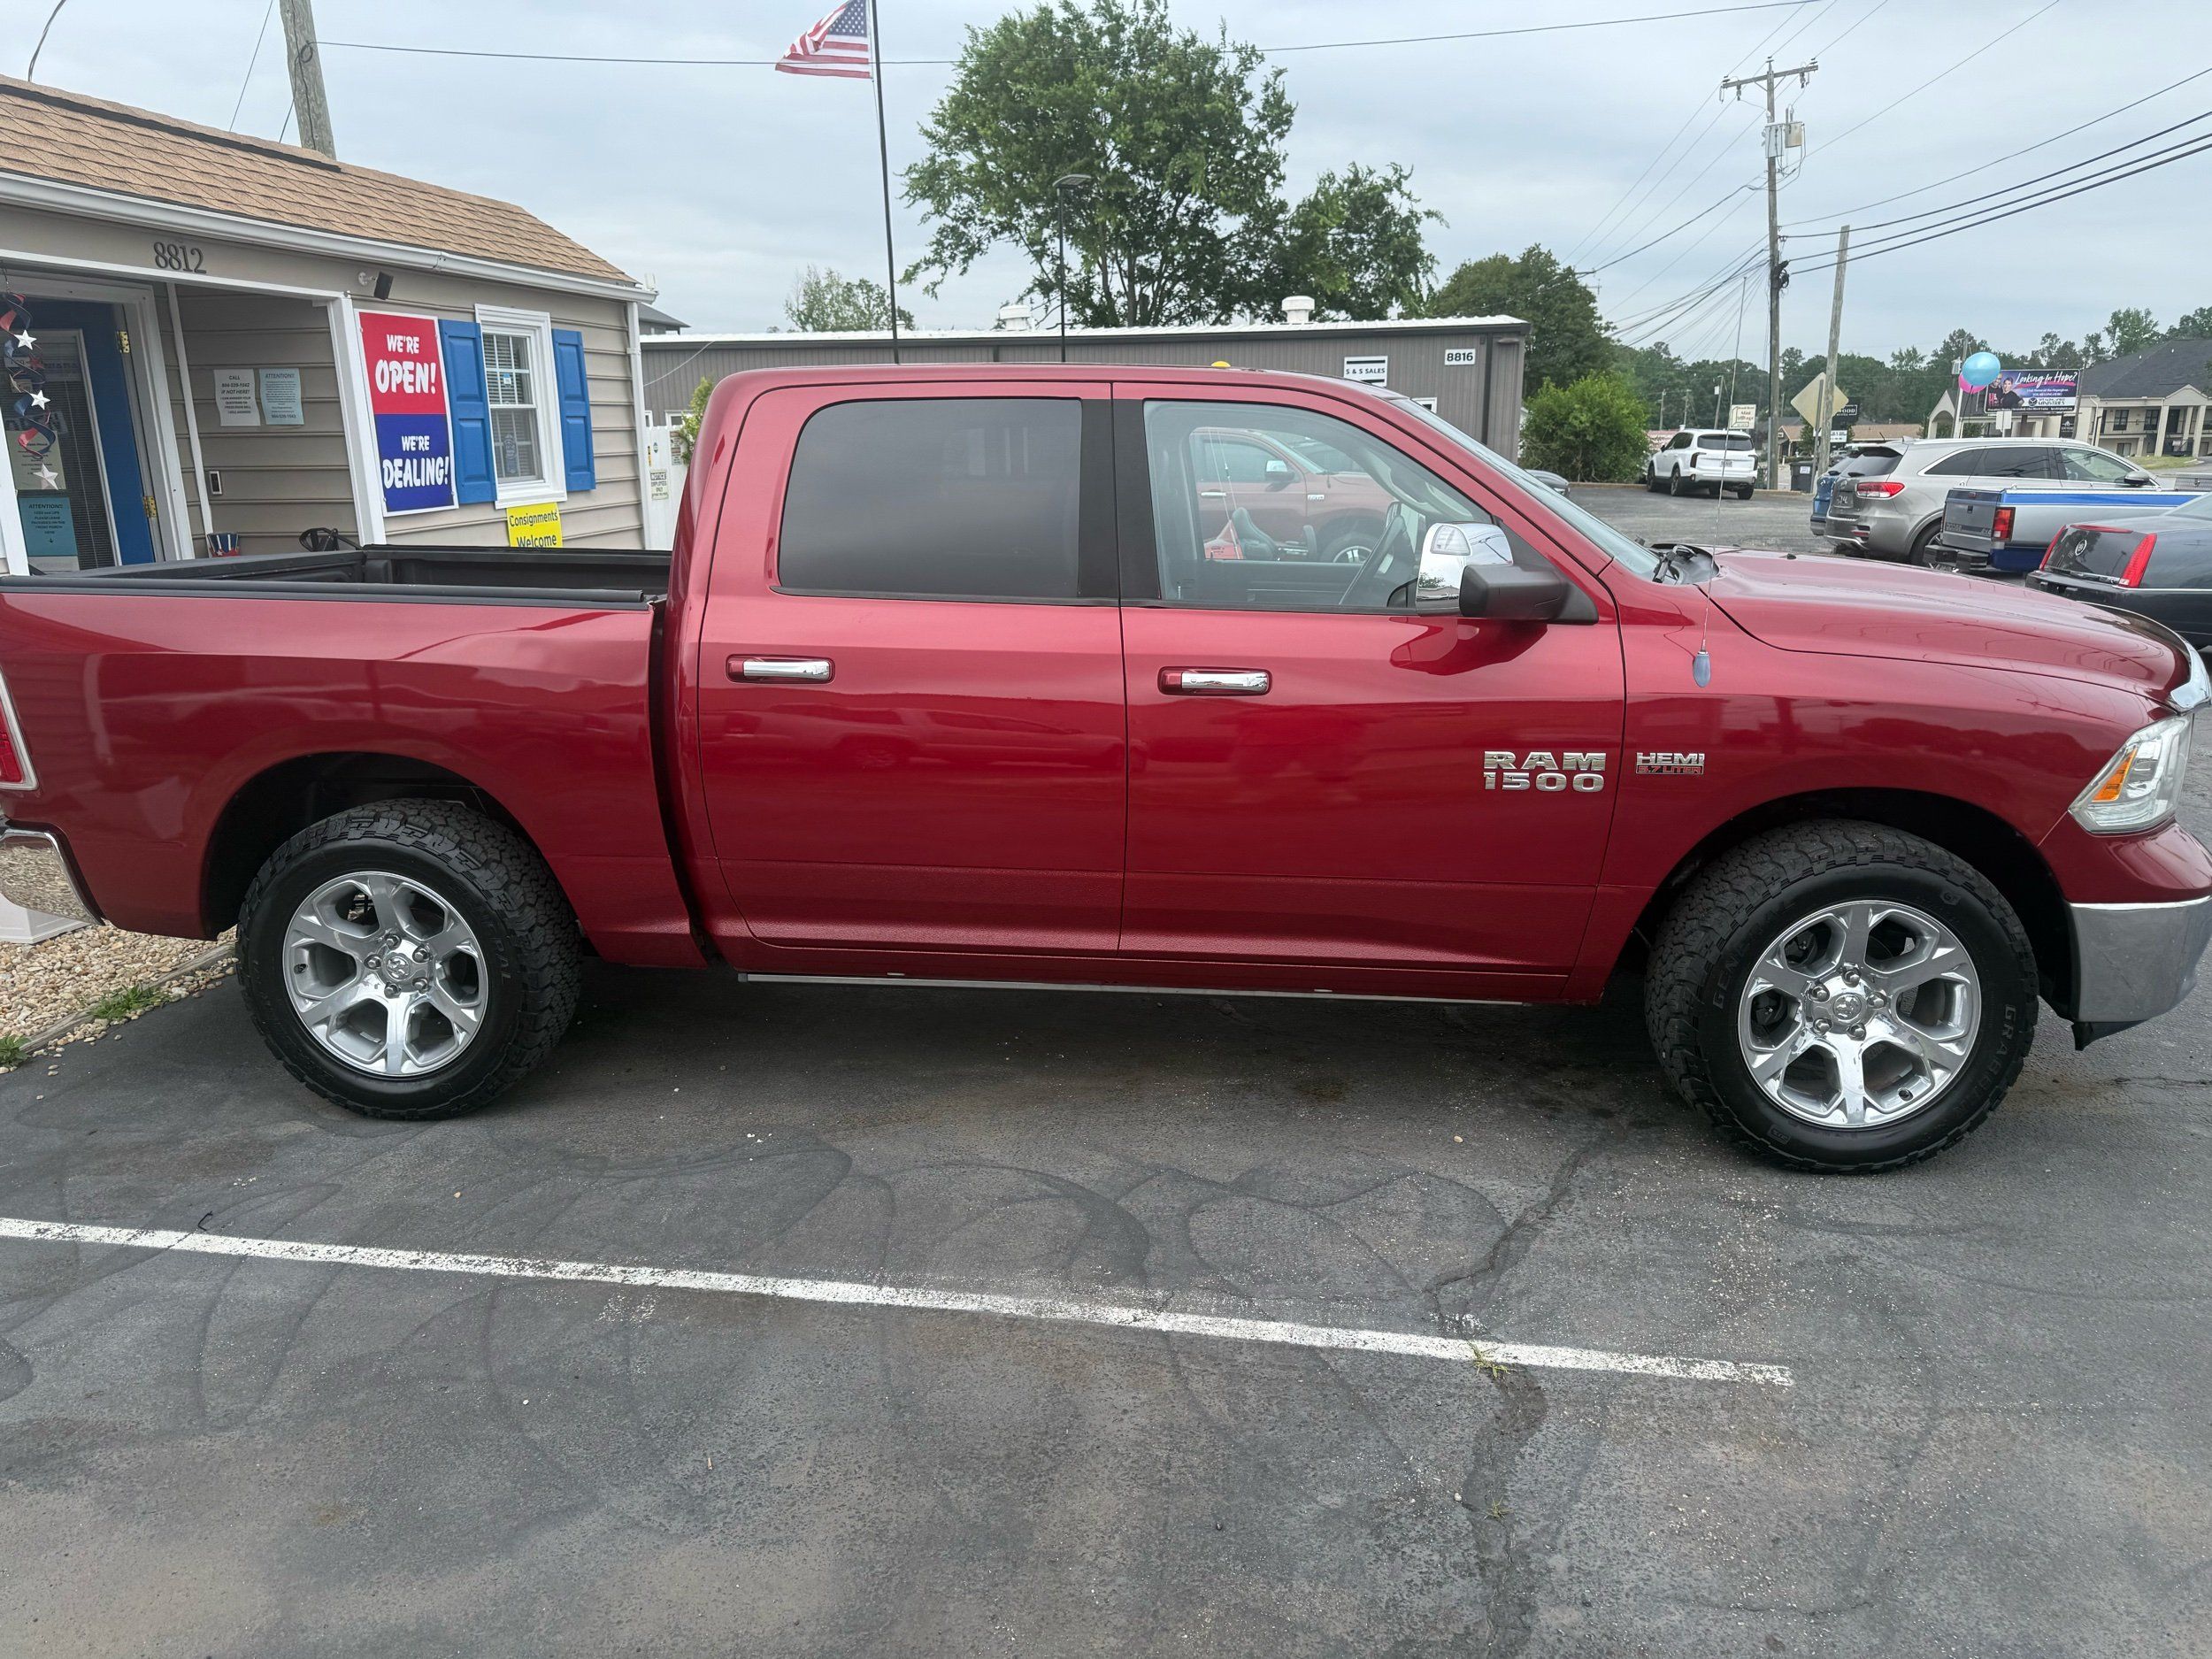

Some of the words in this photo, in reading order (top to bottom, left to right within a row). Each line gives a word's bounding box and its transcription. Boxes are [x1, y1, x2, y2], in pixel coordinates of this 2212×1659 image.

[154, 242, 207, 274] 8812
[386, 334, 420, 355] WE'RE
[1447, 352, 1473, 362] 8816
[375, 359, 436, 395] OPEN!
[2015, 373, 2045, 389] Looking
[2053, 371, 2078, 384] Hope?
[401, 435, 430, 452] WE'RE
[382, 457, 449, 489] DEALING!
[509, 510, 558, 528] Consignments
[516, 534, 558, 548] Welcome
[1484, 750, 1607, 771] RAM
[1636, 752, 1705, 765] HEMI
[1661, 765, 1702, 774] LITER
[1483, 772, 1605, 793] 1500
